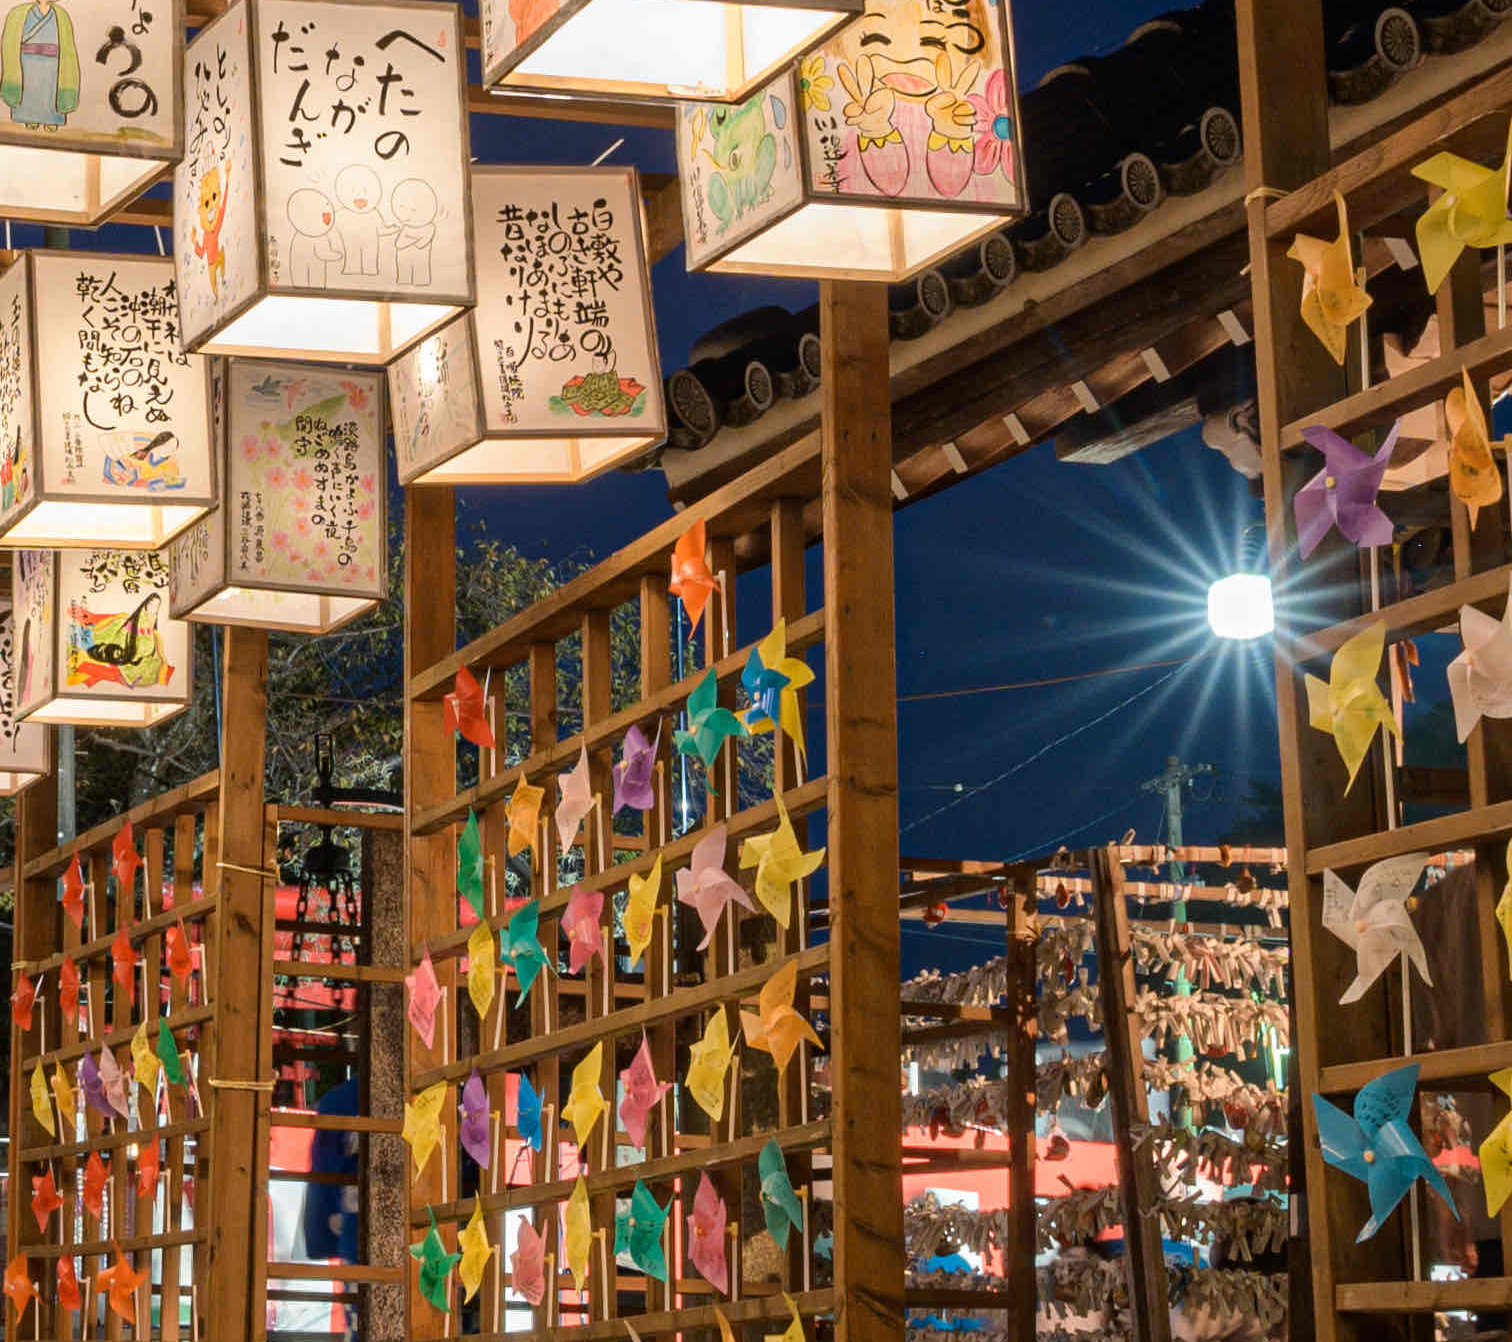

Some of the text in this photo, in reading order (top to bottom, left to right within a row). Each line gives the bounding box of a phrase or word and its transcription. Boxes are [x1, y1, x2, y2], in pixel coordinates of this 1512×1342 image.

[271, 20, 328, 168] だんぎ
[374, 29, 446, 160] へたの
